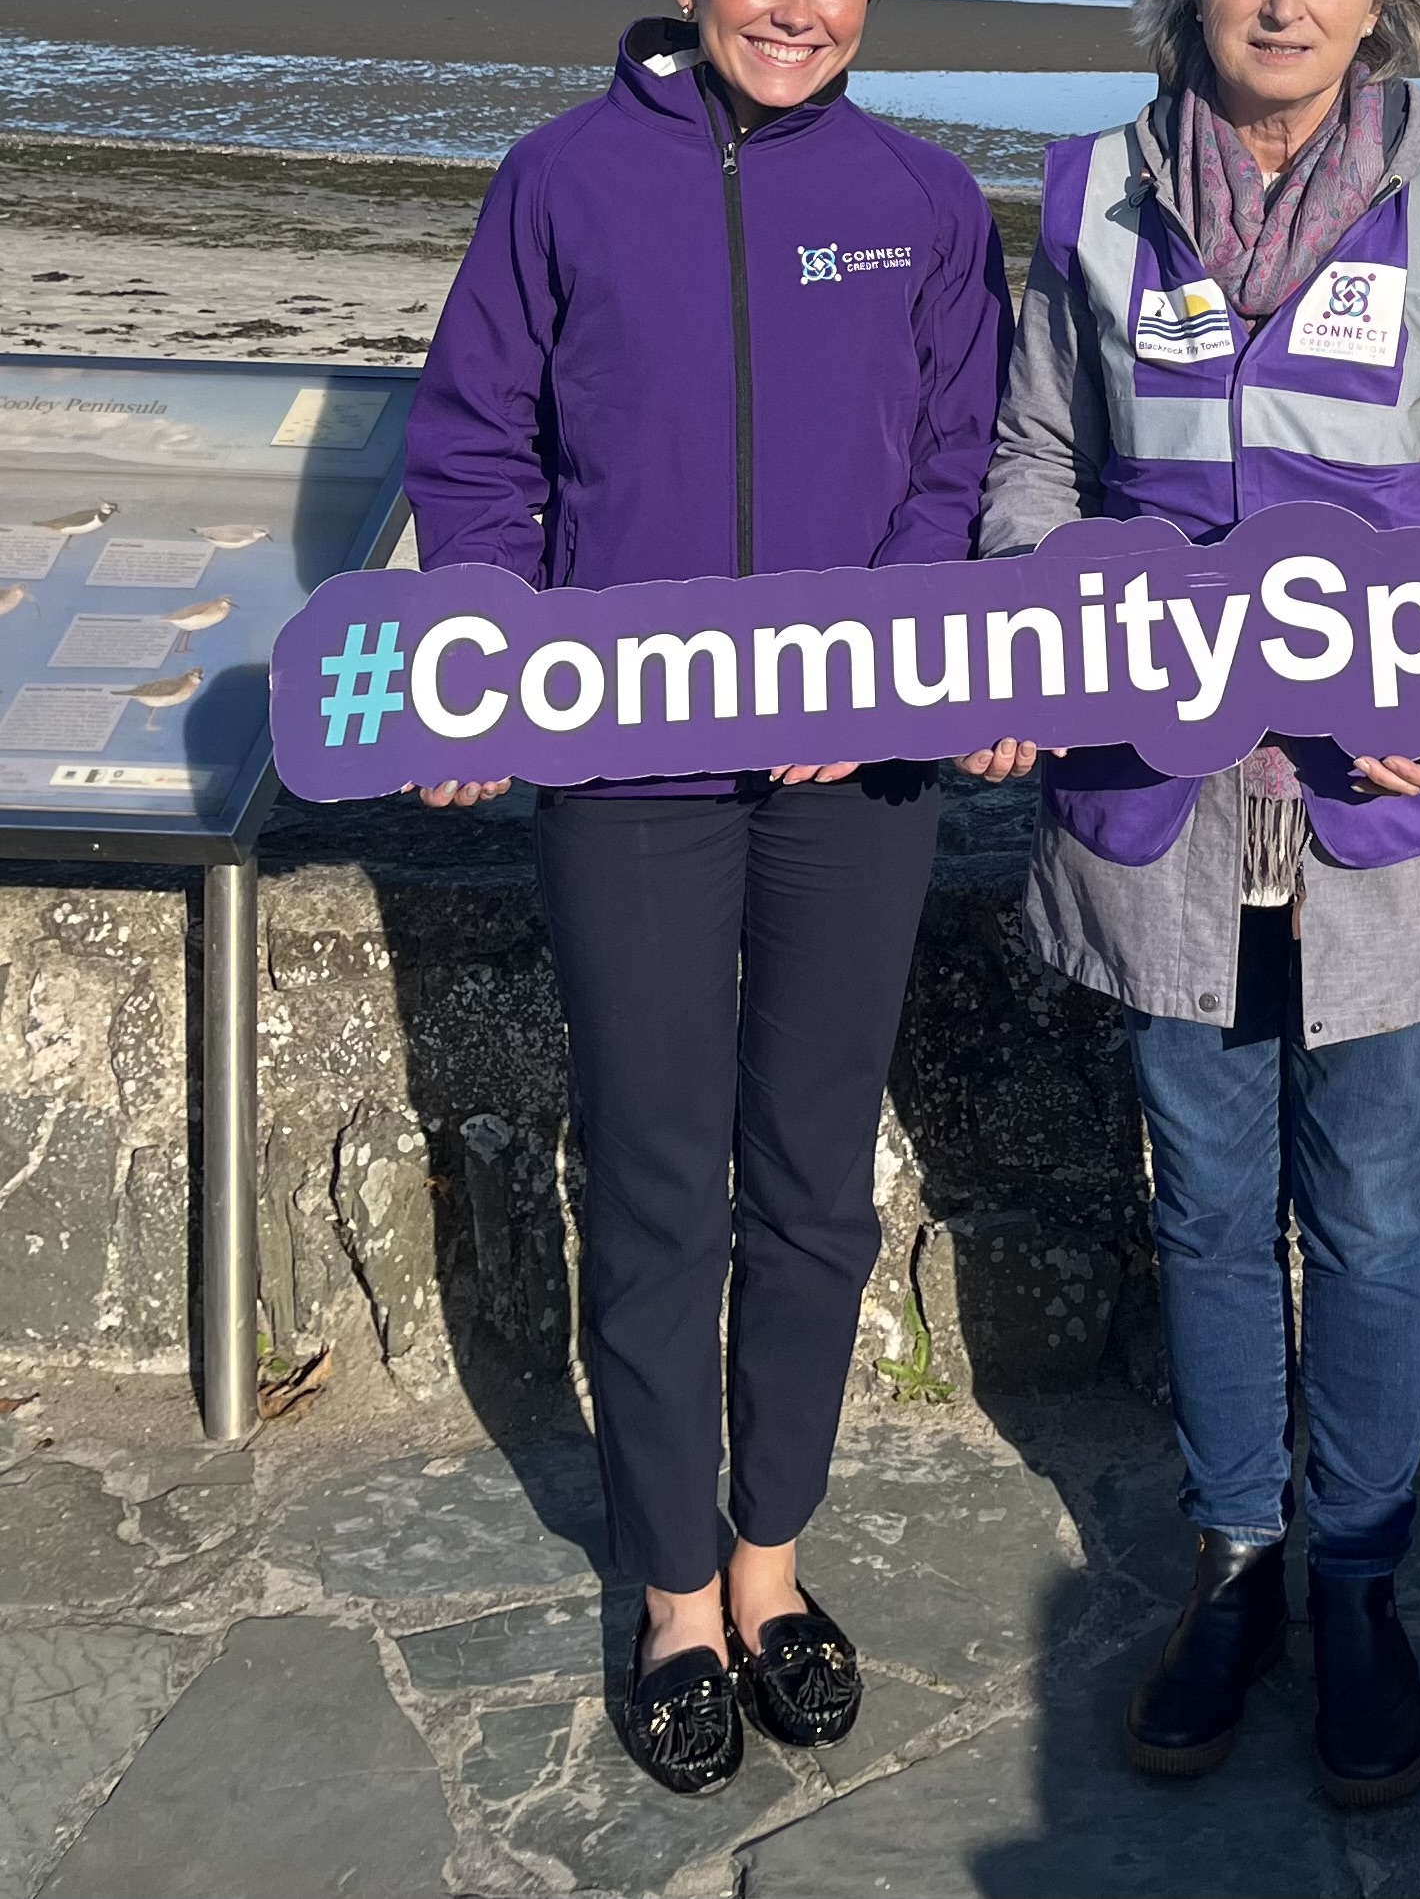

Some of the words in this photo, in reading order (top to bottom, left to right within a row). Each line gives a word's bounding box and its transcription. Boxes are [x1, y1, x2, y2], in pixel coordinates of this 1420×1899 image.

[842, 247, 911, 262] CONNECT
[847, 261, 879, 272] CREDIT
[883, 259, 911, 268] UNION
[1302, 322, 1388, 343] CONNECT
[1138, 341, 1183, 355] Blackrock
[1200, 339, 1231, 351] Towns
[1300, 338, 1342, 348] CREDIT
[1348, 342, 1386, 355] UNION
[64, 397, 168, 415] Peninsula
